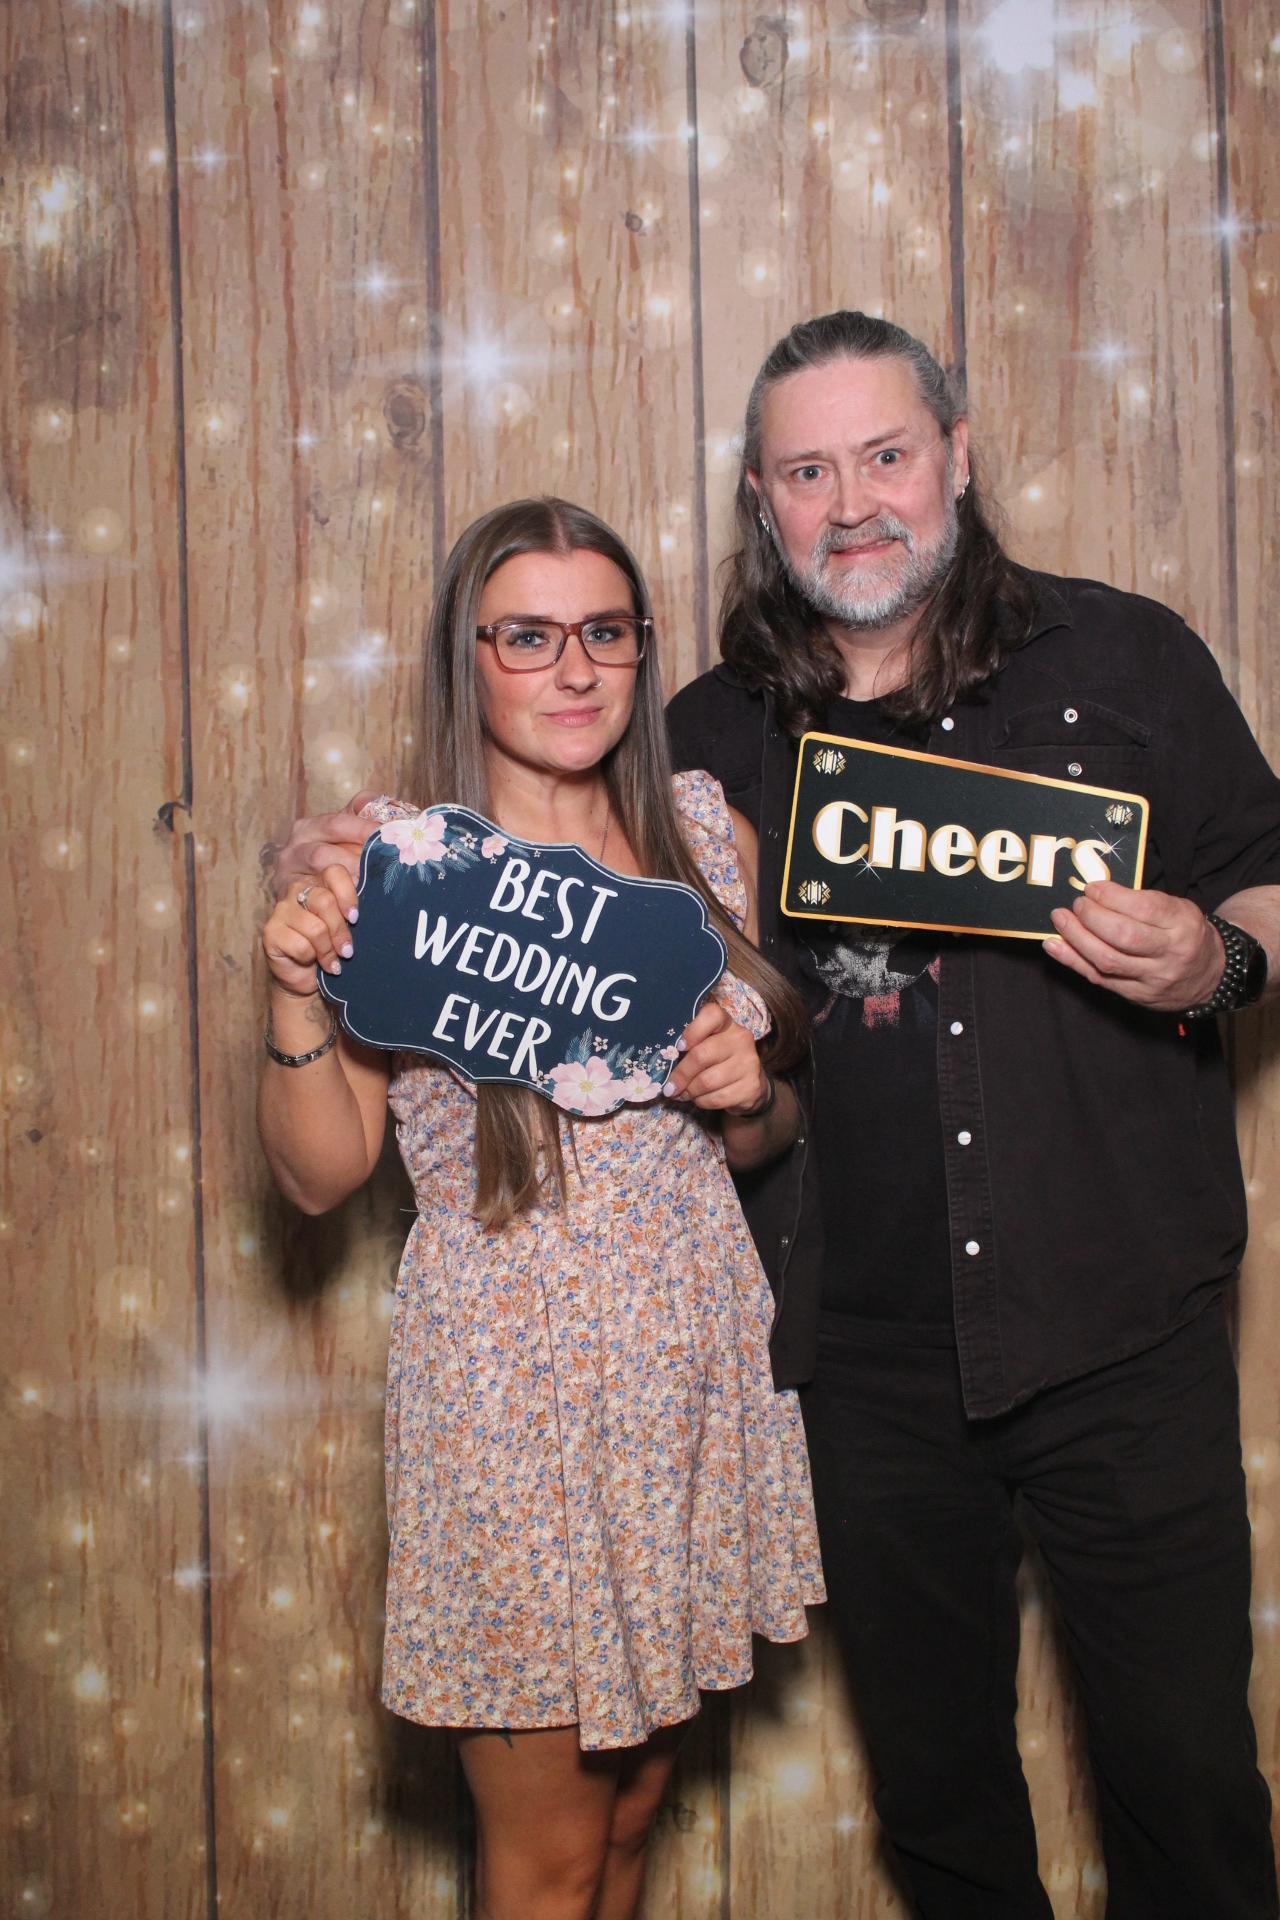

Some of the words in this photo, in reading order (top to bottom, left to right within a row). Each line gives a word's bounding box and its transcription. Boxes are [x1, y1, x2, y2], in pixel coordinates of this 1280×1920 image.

[812, 800, 1112, 891] Cheers
[489, 858, 618, 944] BEST
[413, 909, 637, 1021] WEDDING
[431, 993, 552, 1077] EVER
